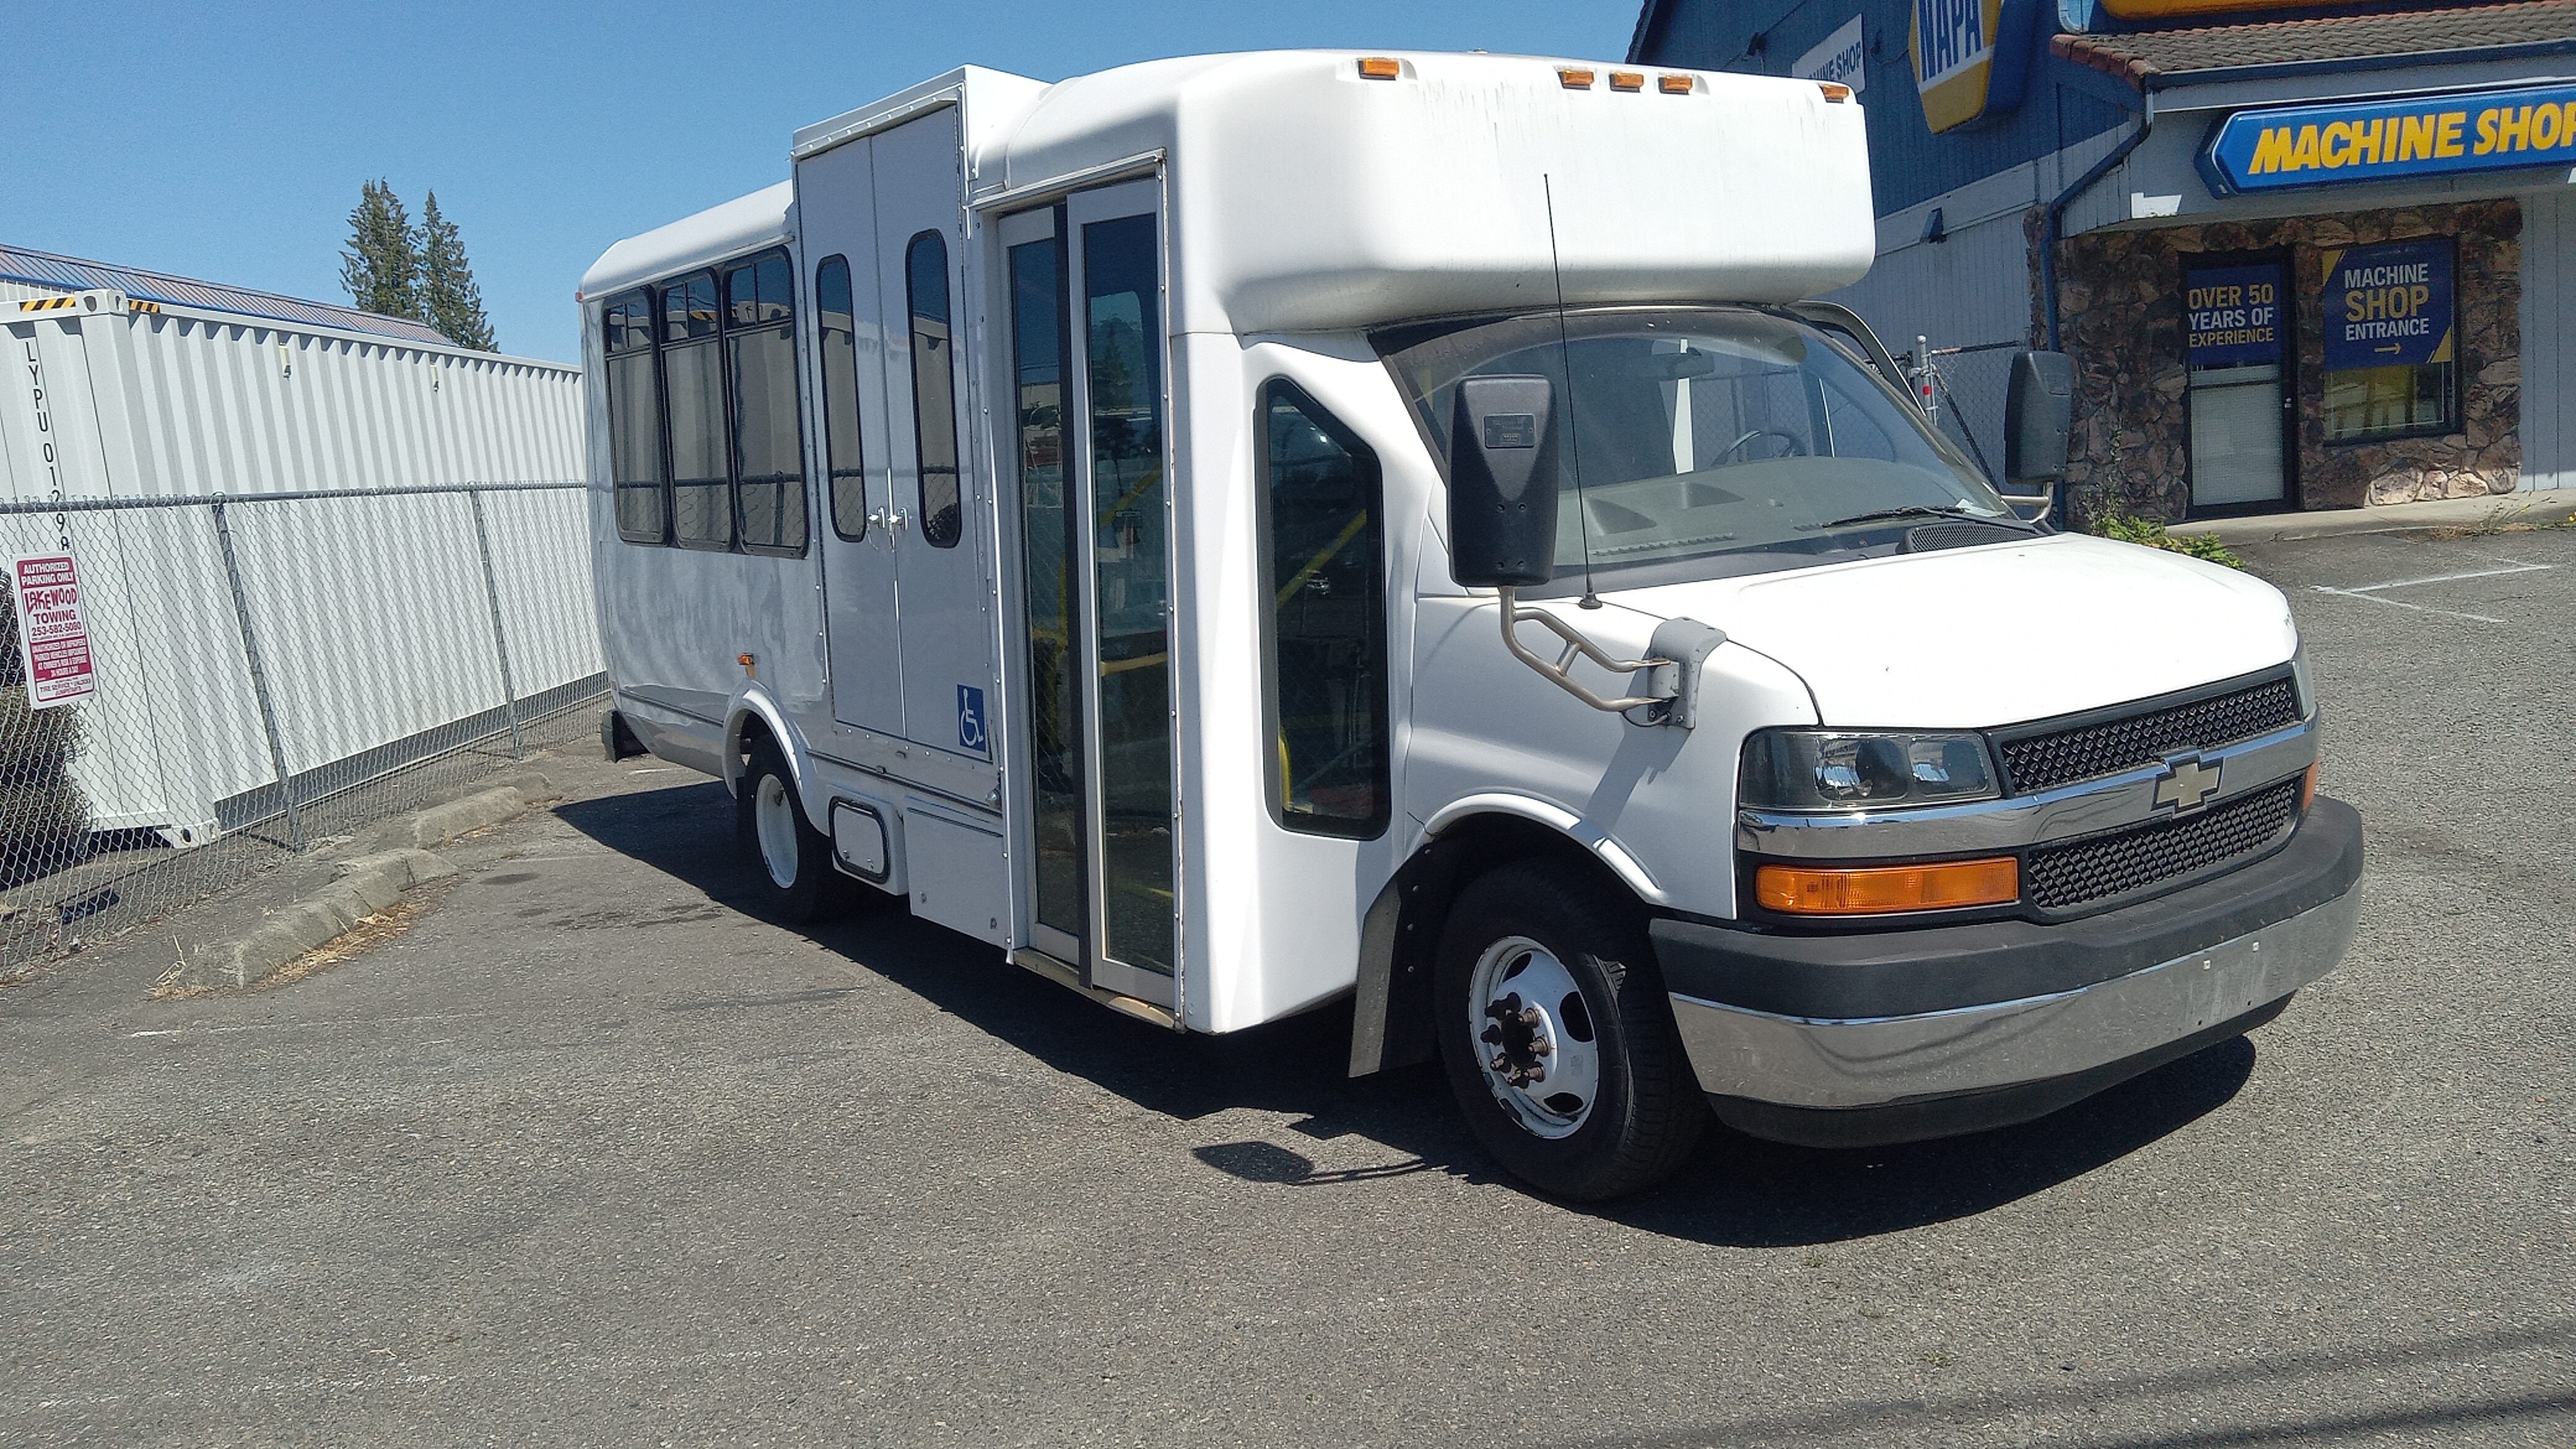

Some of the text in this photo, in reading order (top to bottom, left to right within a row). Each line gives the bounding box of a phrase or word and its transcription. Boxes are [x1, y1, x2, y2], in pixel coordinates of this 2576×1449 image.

[1918, 0, 1981, 82] NAPA
[1836, 40, 1861, 80] SHOP
[2247, 111, 2466, 175] MACHINE
[2344, 263, 2429, 289] MACHINE
[2188, 283, 2274, 309] OVER 50
[2345, 286, 2430, 322] SHOP
[2188, 306, 2274, 331] YEARS OF
[2345, 318, 2430, 341] ENTRANCE
[2188, 327, 2274, 348] EXPERIENCE
[25, 341, 48, 432] LYPU
[21, 572, 74, 586] PARKING ONLY
[24, 562, 69, 574] AUTHORIZED
[24, 588, 77, 615] LAKEWOOD
[33, 609, 77, 625] TOWING
